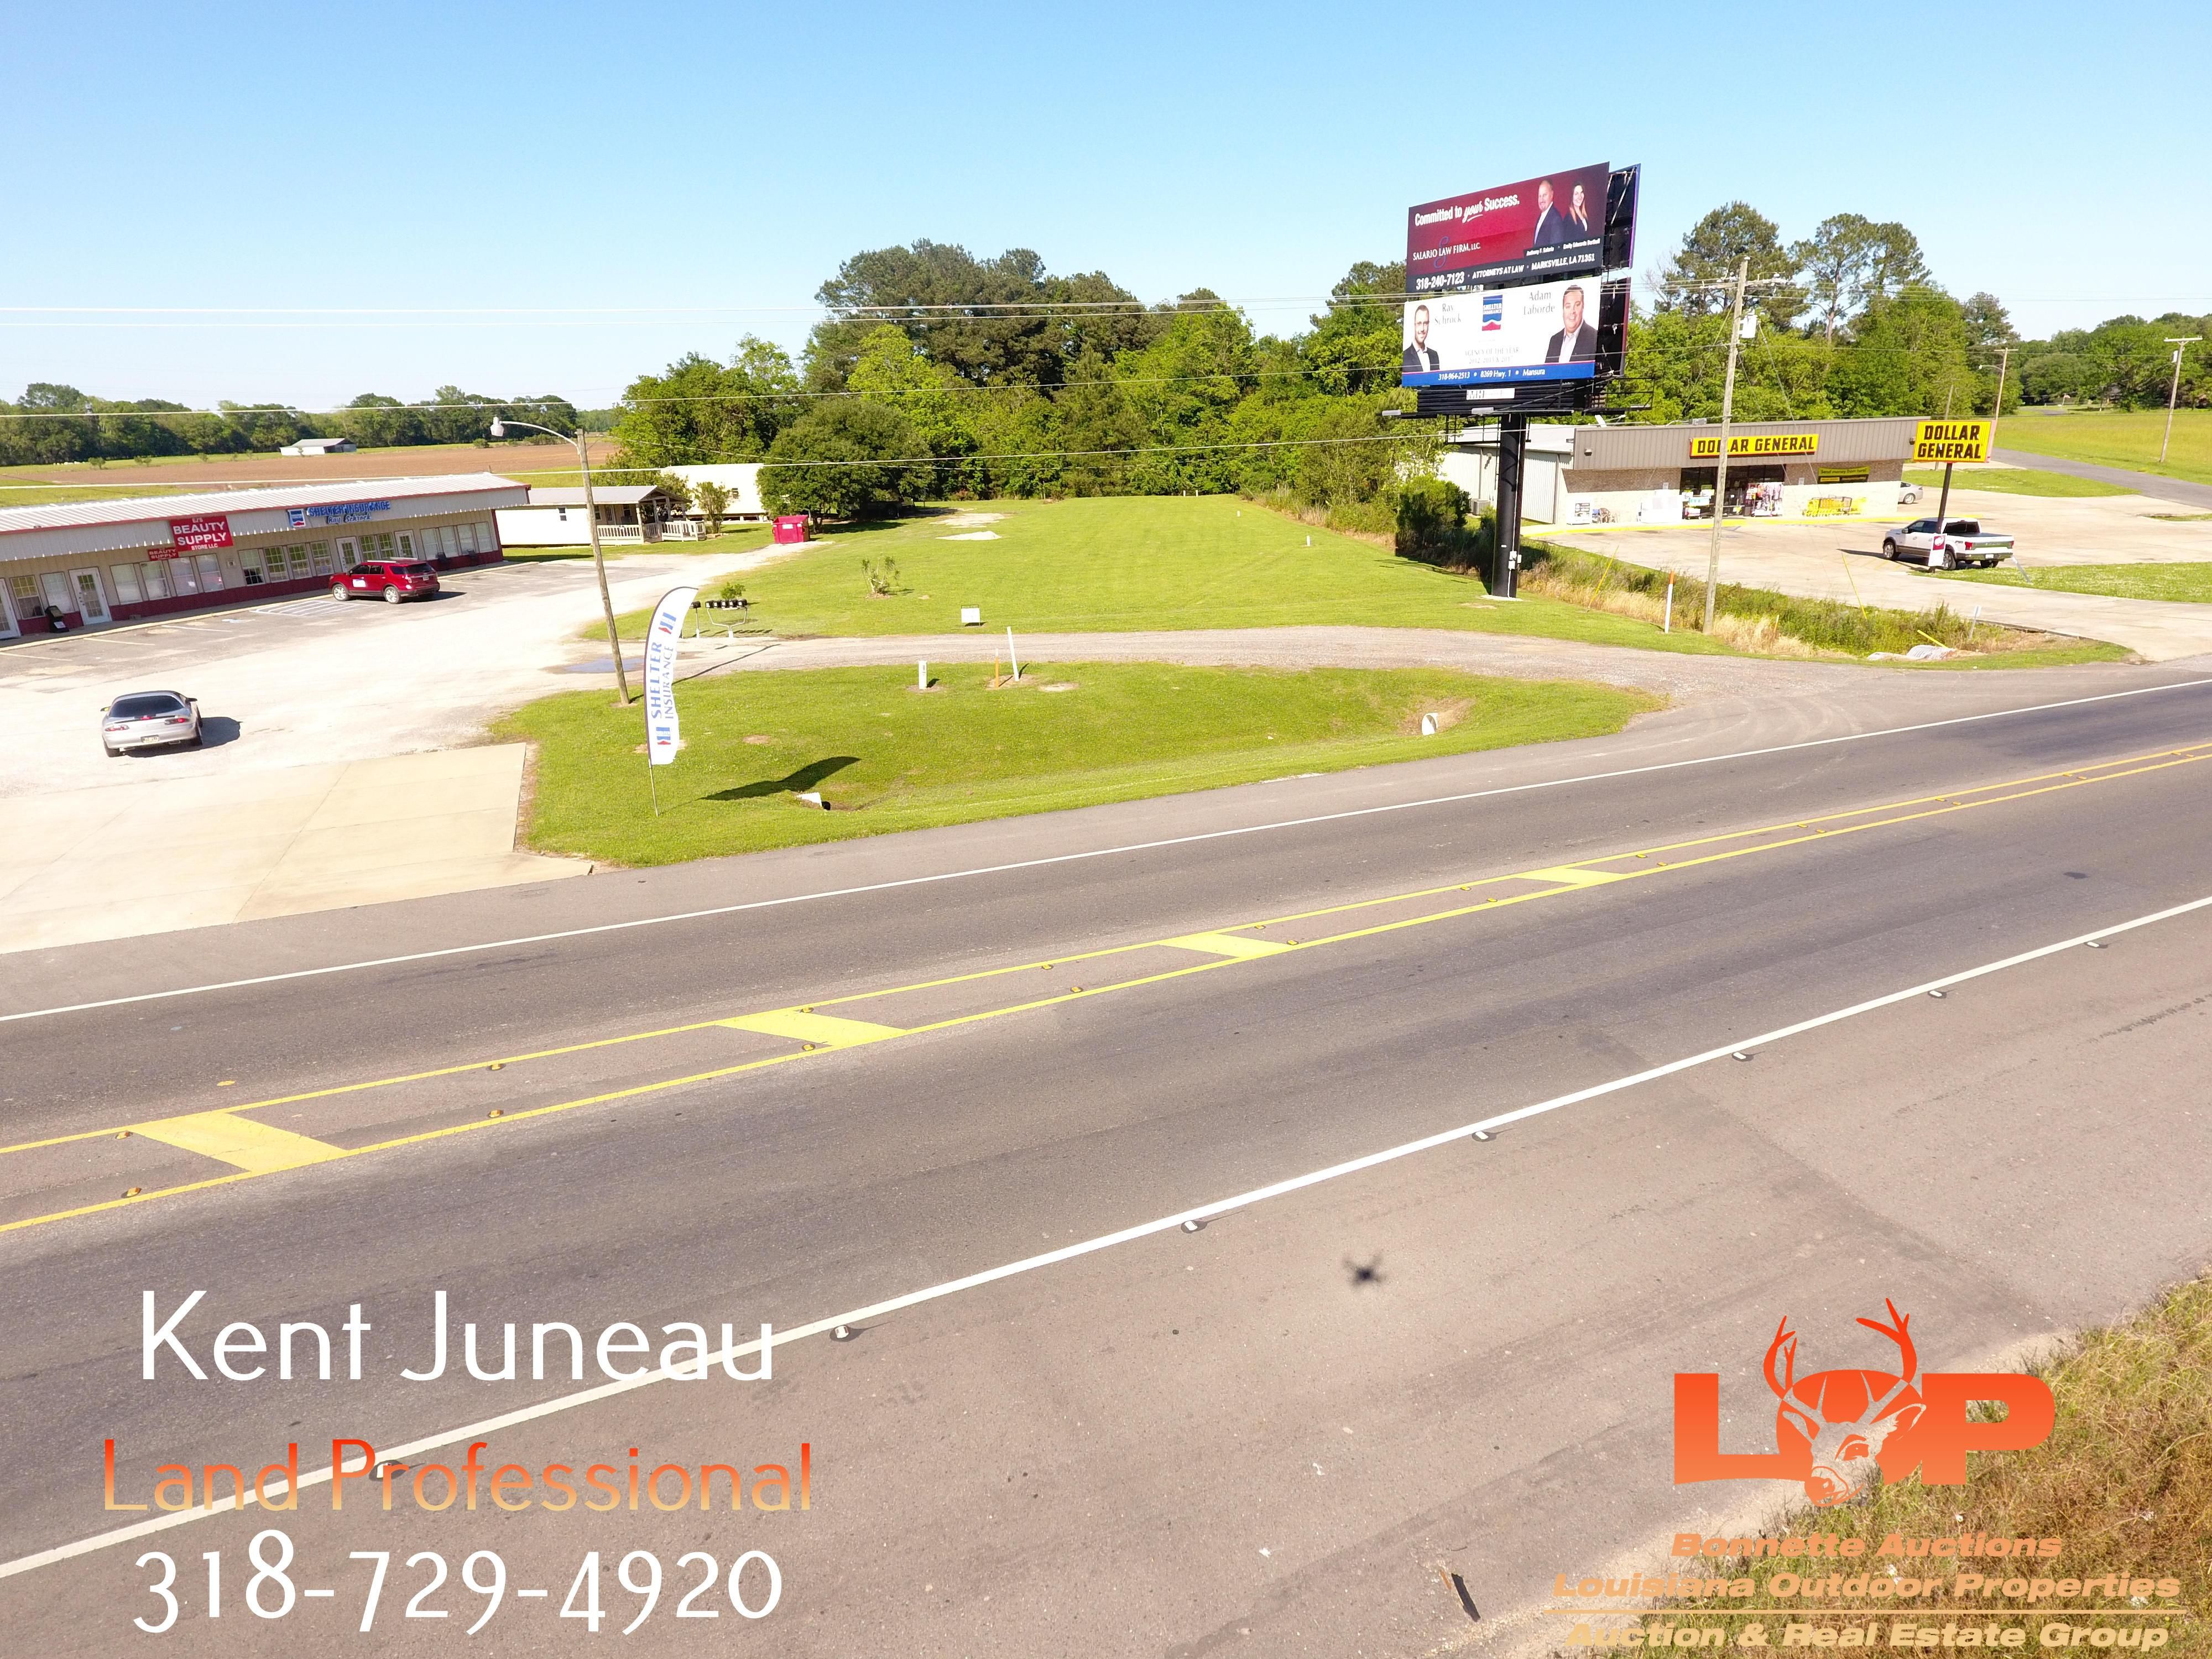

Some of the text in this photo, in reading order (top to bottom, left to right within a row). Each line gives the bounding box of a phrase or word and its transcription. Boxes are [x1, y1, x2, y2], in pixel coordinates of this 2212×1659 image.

[1415, 194, 1520, 226] Committed to your Success.
[1412, 249, 1437, 260] SALARIO
[1439, 246, 1452, 257] LAW
[1453, 243, 1470, 254] FIRM,
[1531, 253, 1595, 270] MARKSVILLE, LA 71351
[1472, 264, 1525, 279] ATTORNEYS AT LAW
[1416, 271, 1465, 290] 318-240-7123
[1528, 290, 1552, 301] Adam
[1438, 372, 1470, 380] 318-964-2513
[1494, 370, 1506, 379] Hwy.
[1522, 368, 1546, 377] Mansura
[1924, 425, 1980, 440] DOLLAR
[1697, 436, 1814, 453] DOLAR GENERAL
[1917, 443, 1981, 458] GENERAL
[307, 501, 390, 517] SHELTER INSURANCE
[328, 515, 341, 524] Ray
[173, 521, 225, 535] BEAUTY
[178, 533, 226, 546] SUPPLY
[650, 641, 662, 719] SHELTER
[662, 645, 674, 719] INSURANCE
